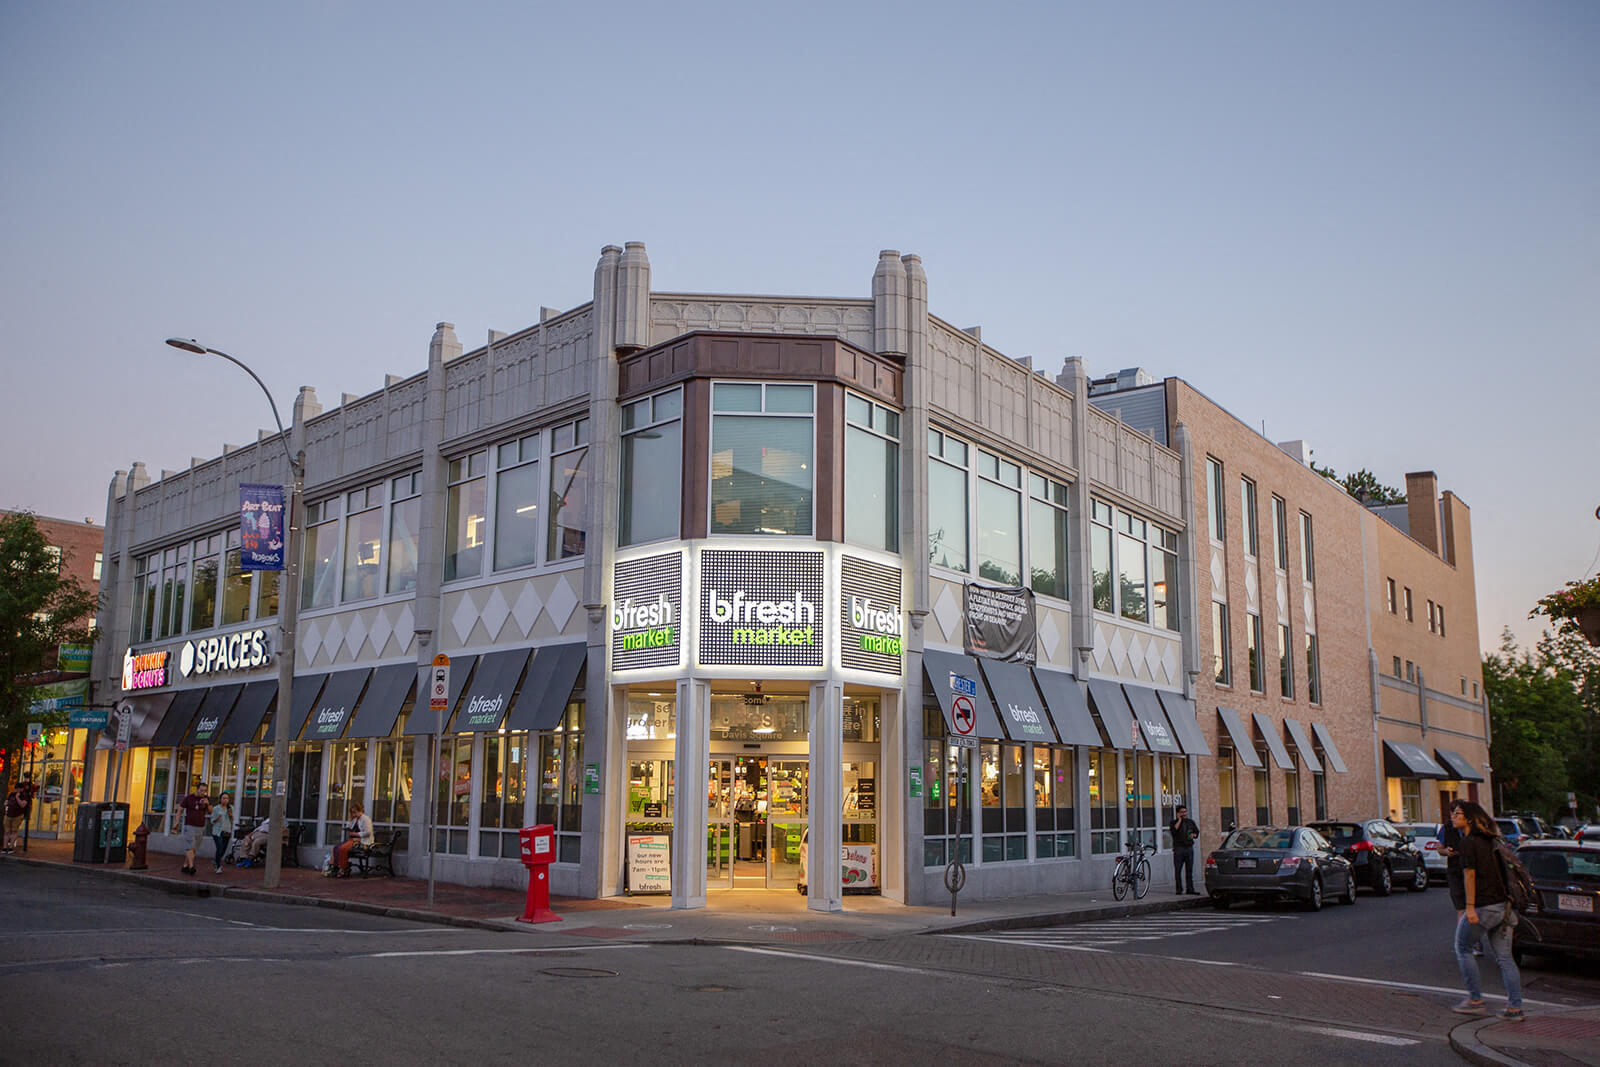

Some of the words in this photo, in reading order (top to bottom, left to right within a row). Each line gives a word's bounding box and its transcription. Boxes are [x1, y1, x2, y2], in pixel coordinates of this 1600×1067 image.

[612, 593, 673, 630] bfresh
[709, 589, 815, 623] bfresh
[849, 596, 904, 634] bfresh
[623, 626, 674, 650] market
[733, 625, 815, 645] market
[862, 634, 904, 655] market
[133, 668, 164, 689] DONUTS
[468, 694, 503, 713] bfresh
[1008, 703, 1040, 723] bfresh
[197, 716, 218, 731] bfresh
[318, 706, 344, 723] bfresh
[469, 712, 496, 724] market
[317, 723, 339, 733] market
[721, 731, 747, 739] Davis
[1144, 720, 1168, 737] bfresh
